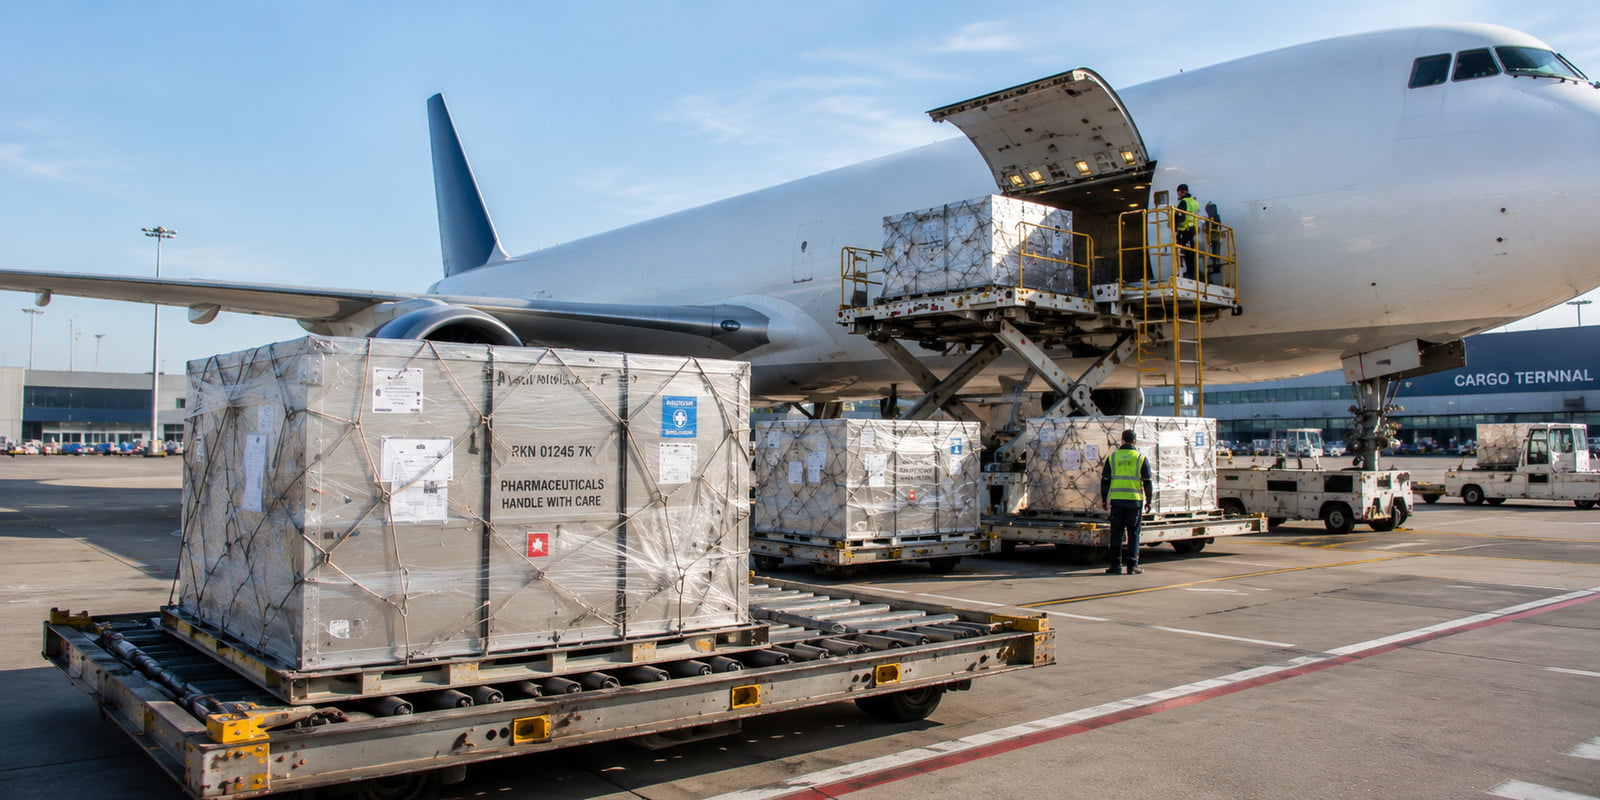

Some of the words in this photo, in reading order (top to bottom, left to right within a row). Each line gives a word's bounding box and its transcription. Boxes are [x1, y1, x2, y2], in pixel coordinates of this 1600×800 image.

[1454, 372, 1510, 387] CARGO
[1514, 369, 1594, 385] TERNNAL
[511, 445, 536, 458] RKN
[540, 445, 575, 458] 01245
[500, 478, 605, 492] PHARMACEUTICALS
[501, 496, 544, 509] HANDLE
[547, 495, 572, 508] WITH
[575, 494, 601, 507] CARE
